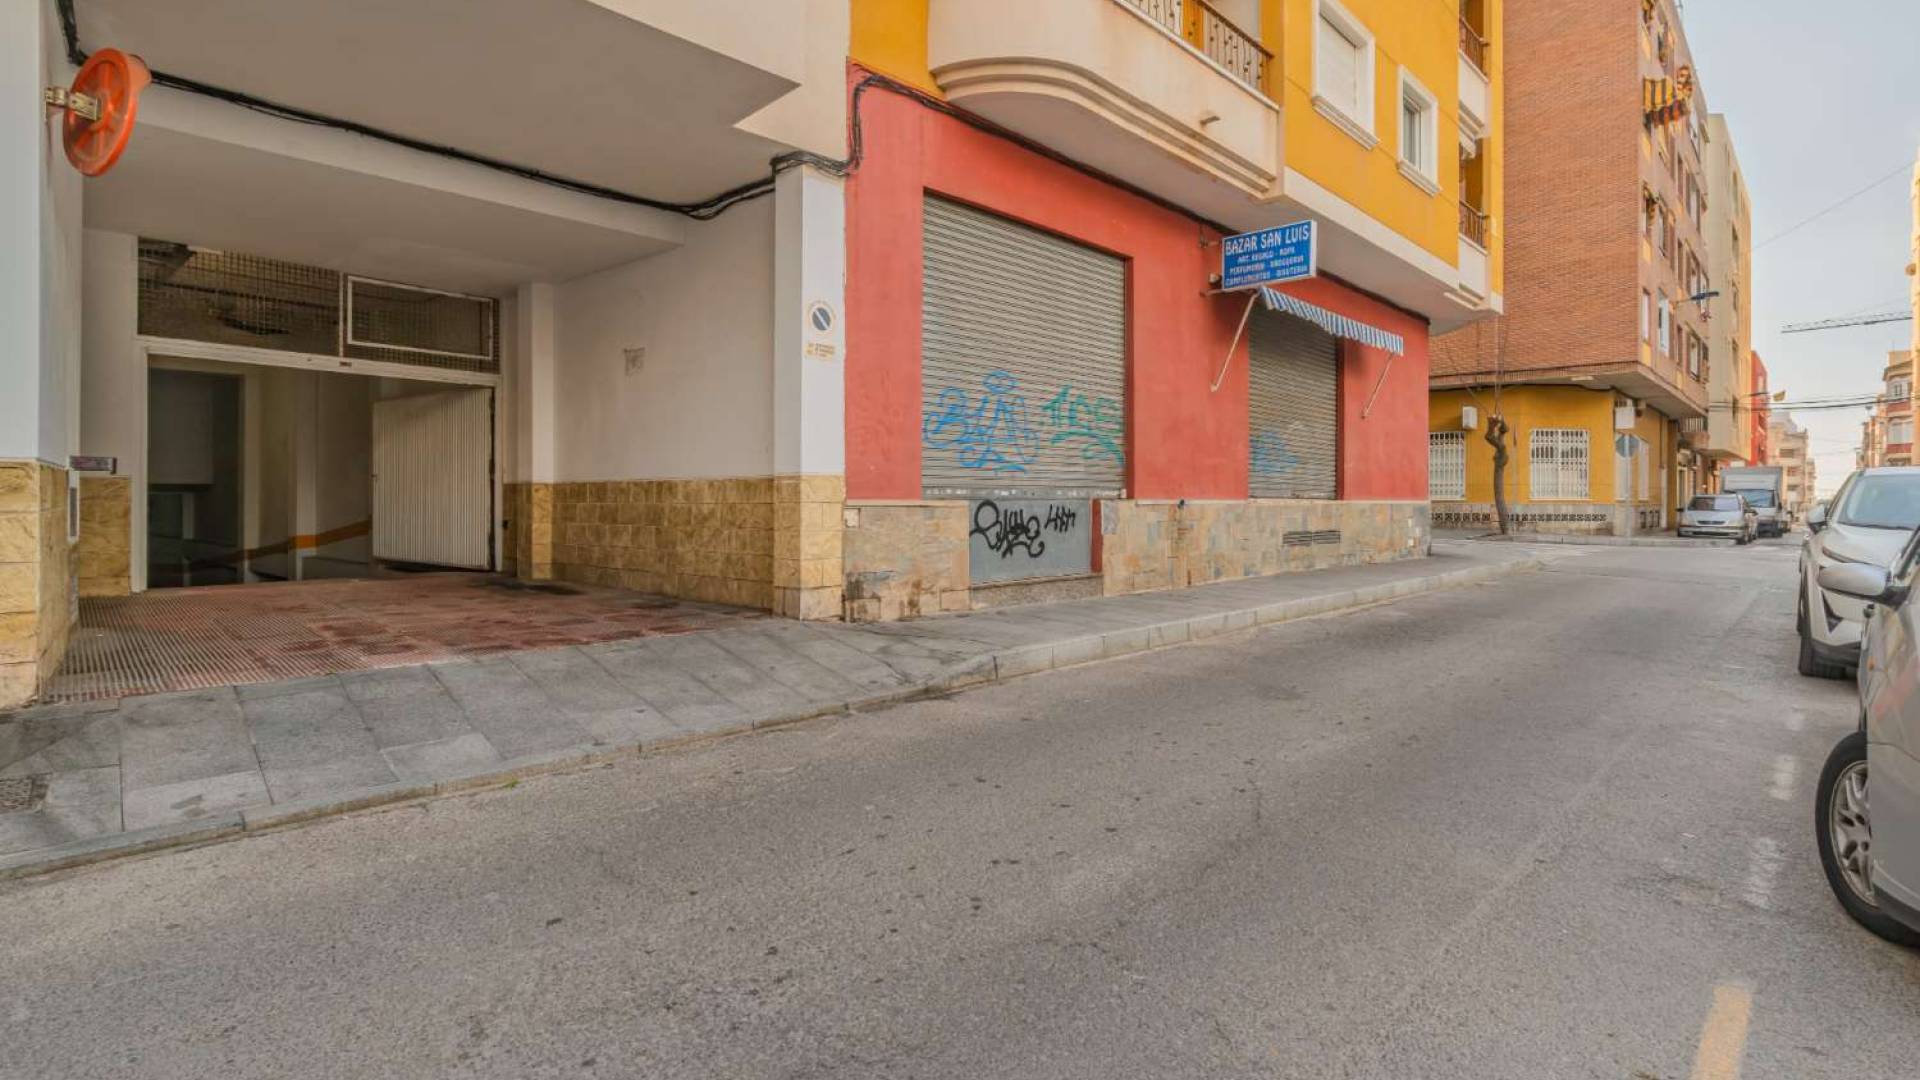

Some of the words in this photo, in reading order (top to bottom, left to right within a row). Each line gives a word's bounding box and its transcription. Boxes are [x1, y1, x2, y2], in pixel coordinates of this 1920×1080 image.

[1225, 236, 1258, 256] BAZAR
[1260, 231, 1281, 249] SAN
[1285, 224, 1309, 244] LUIS
